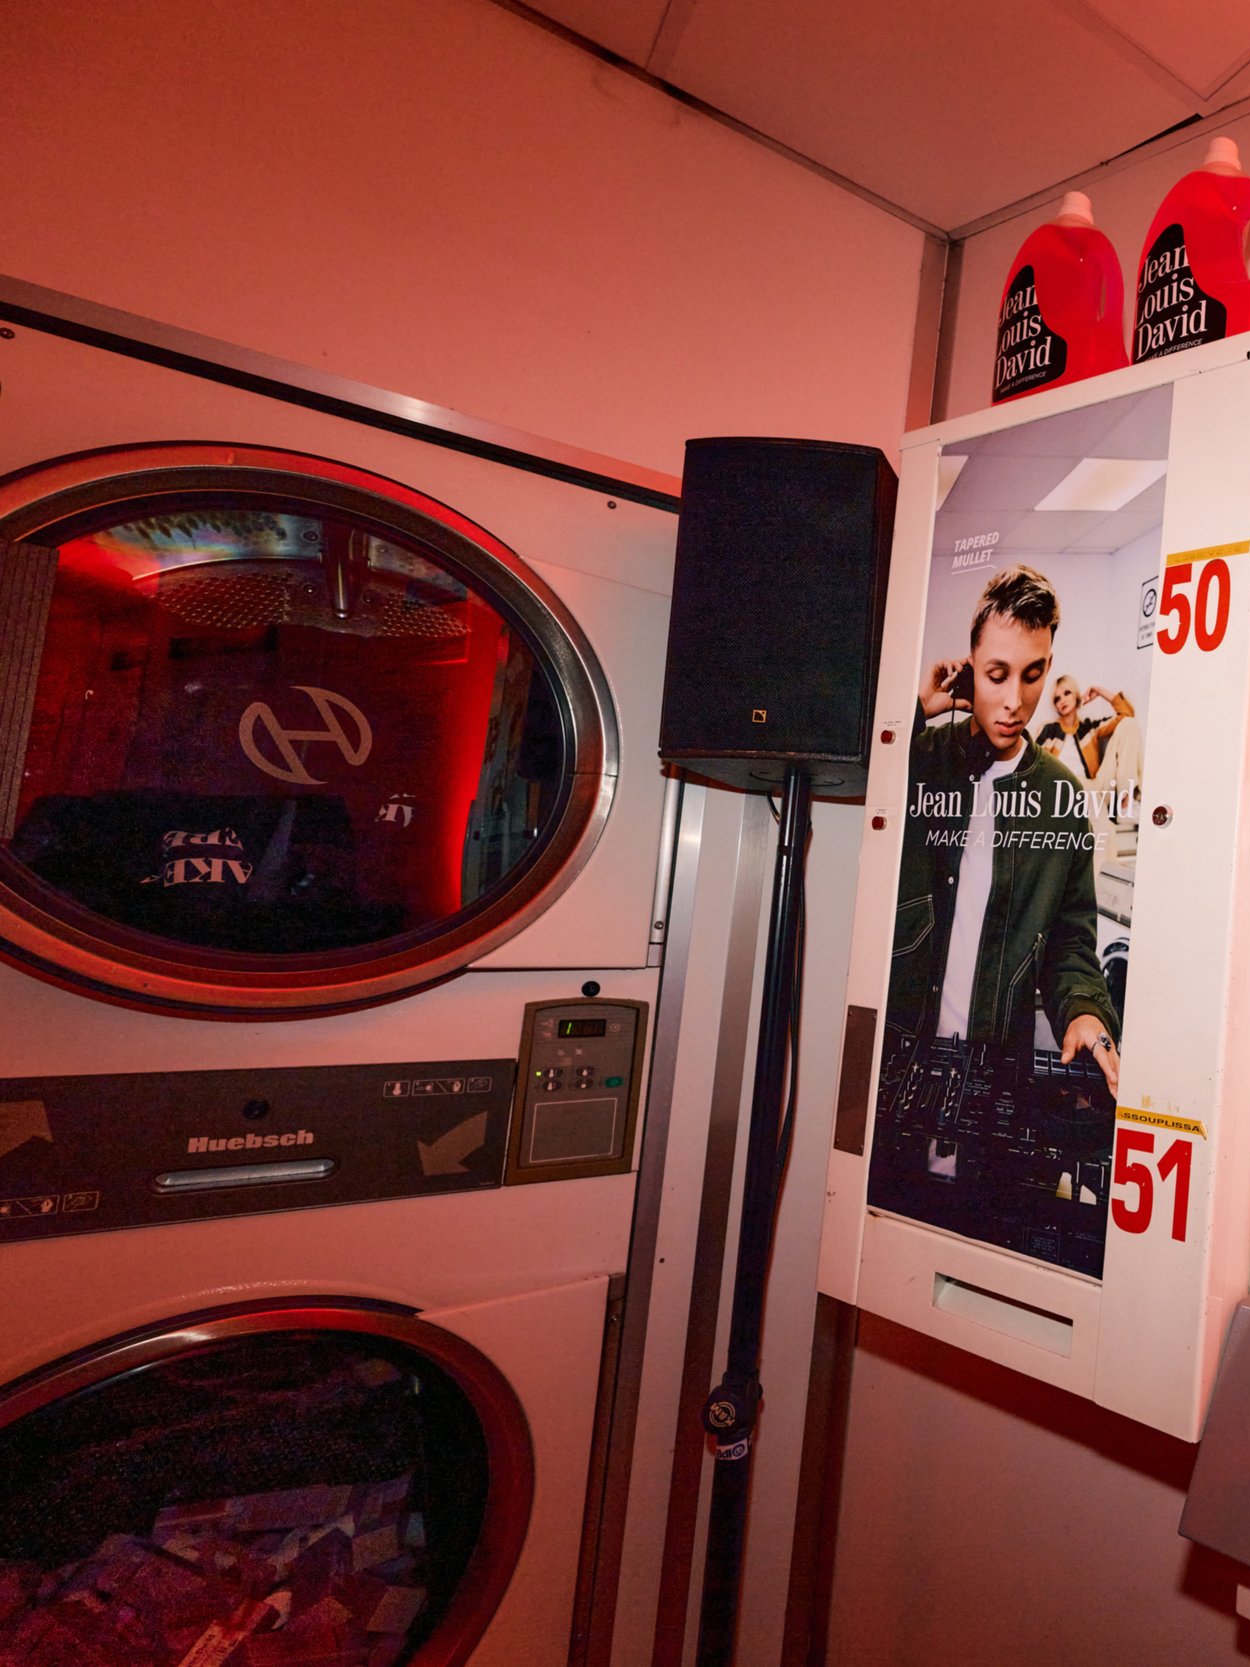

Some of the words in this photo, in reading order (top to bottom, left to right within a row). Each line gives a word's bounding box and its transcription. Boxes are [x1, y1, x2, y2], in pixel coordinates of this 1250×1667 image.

[1139, 245, 1190, 293] Jean
[1000, 285, 1038, 327] Jean
[1136, 300, 1208, 360] David
[1164, 338, 1204, 355] DIFFERENCE
[995, 336, 1053, 389] David
[1015, 371, 1048, 386] DIFFERENCE
[952, 548, 994, 568] MULLET
[954, 531, 1000, 553] TAPERED
[1157, 558, 1231, 654] 50
[909, 782, 962, 818] Jean
[969, 780, 1042, 818] Louis
[1051, 779, 1137, 819] David
[925, 830, 971, 847] MAKE
[972, 831, 985, 847] A
[991, 831, 1108, 850] DIFFERENCE
[187, 1129, 314, 1154] Huebsch
[1111, 1128, 1192, 1242] 51
